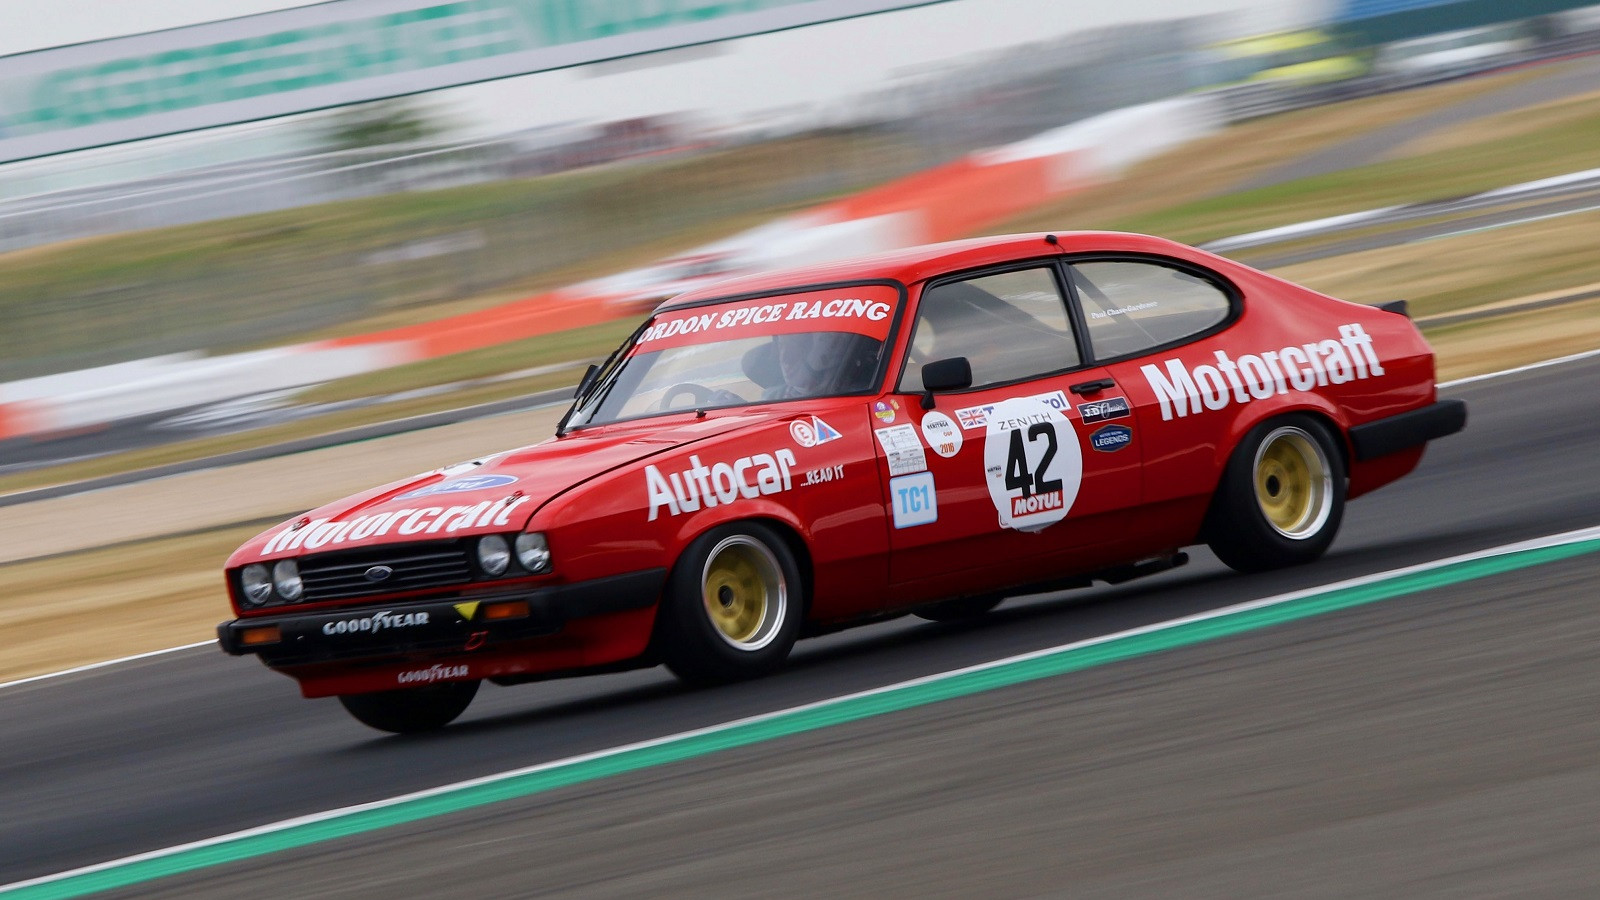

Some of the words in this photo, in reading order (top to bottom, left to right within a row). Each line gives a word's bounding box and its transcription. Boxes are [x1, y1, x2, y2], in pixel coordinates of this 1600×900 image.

[636, 312, 718, 345] ORDON
[716, 303, 787, 329] SPICE
[786, 299, 891, 321] RACING
[1140, 323, 1385, 422] Motorcraft
[998, 412, 1052, 430] ZENITH
[1095, 433, 1129, 447] LEGENDS
[834, 464, 844, 480] IT
[1005, 422, 1063, 499] 42
[645, 448, 797, 522] Autocar
[898, 484, 930, 515] TC1
[1013, 490, 1062, 516] MOTUL
[260, 495, 531, 556] Motorcraft
[322, 610, 430, 636] GOODYEAR
[397, 663, 469, 683] GOODYEAR
